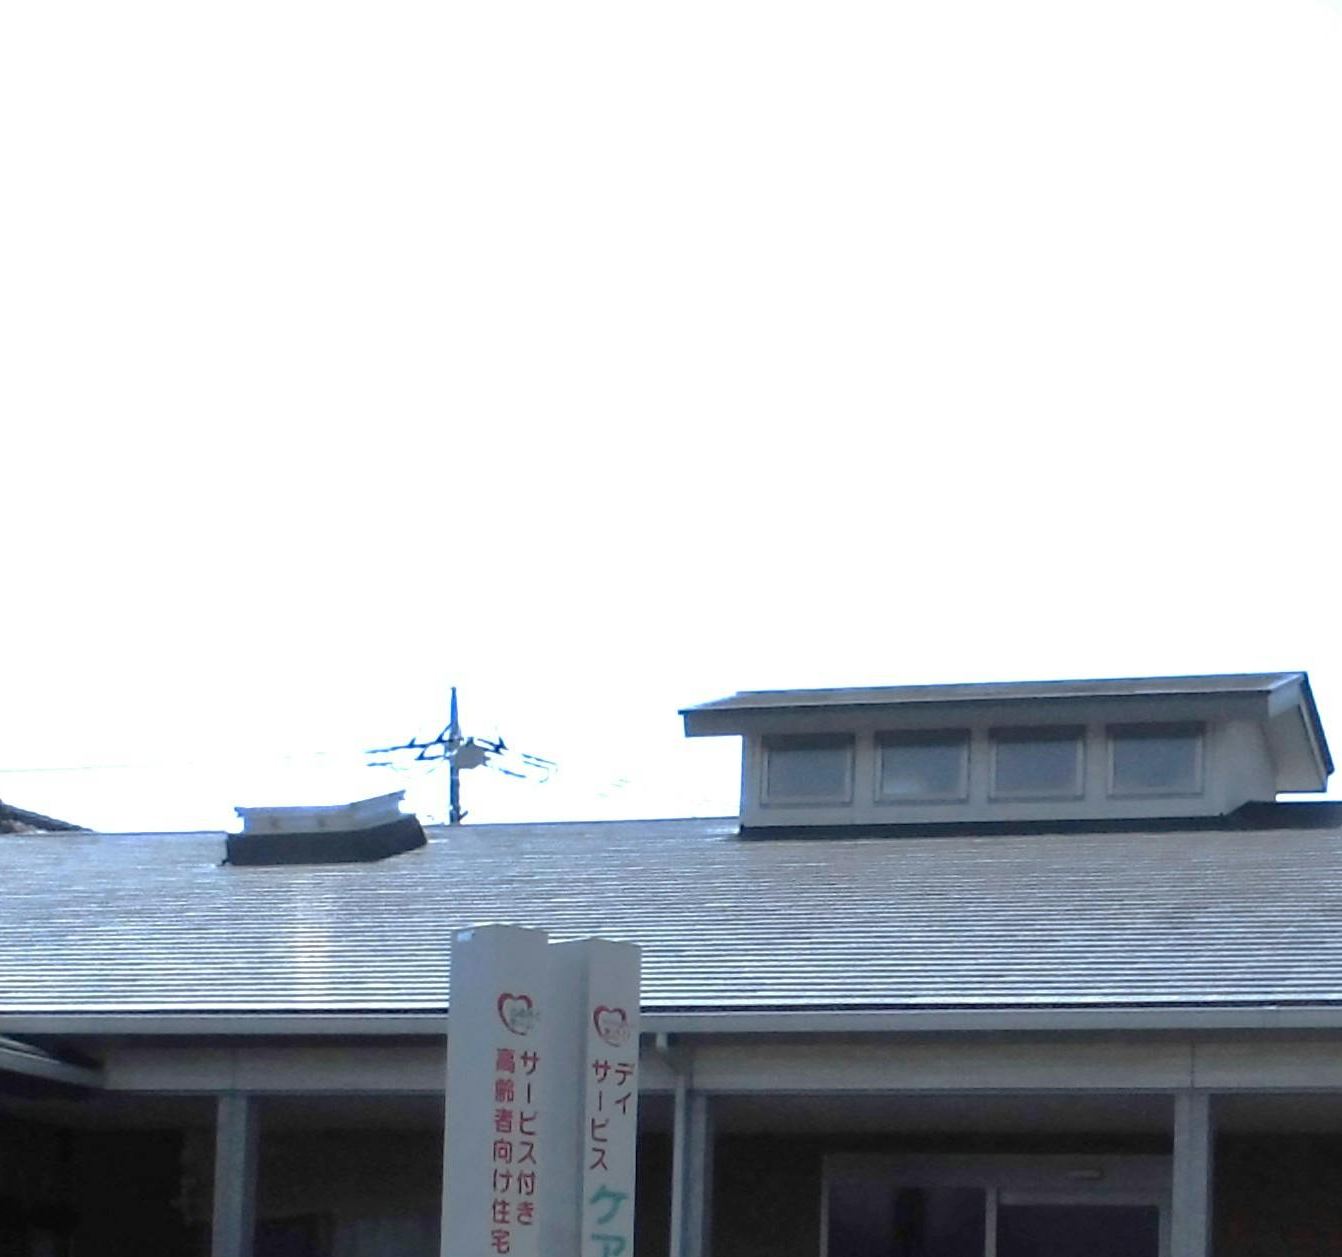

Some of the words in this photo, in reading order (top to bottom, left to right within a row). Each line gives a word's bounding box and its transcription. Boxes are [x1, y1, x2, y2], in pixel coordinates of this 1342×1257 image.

[491, 1048, 516, 1255] 高齢者向け住宅
[516, 1050, 540, 1226] サービス付き
[589, 1059, 612, 1171] サービス
